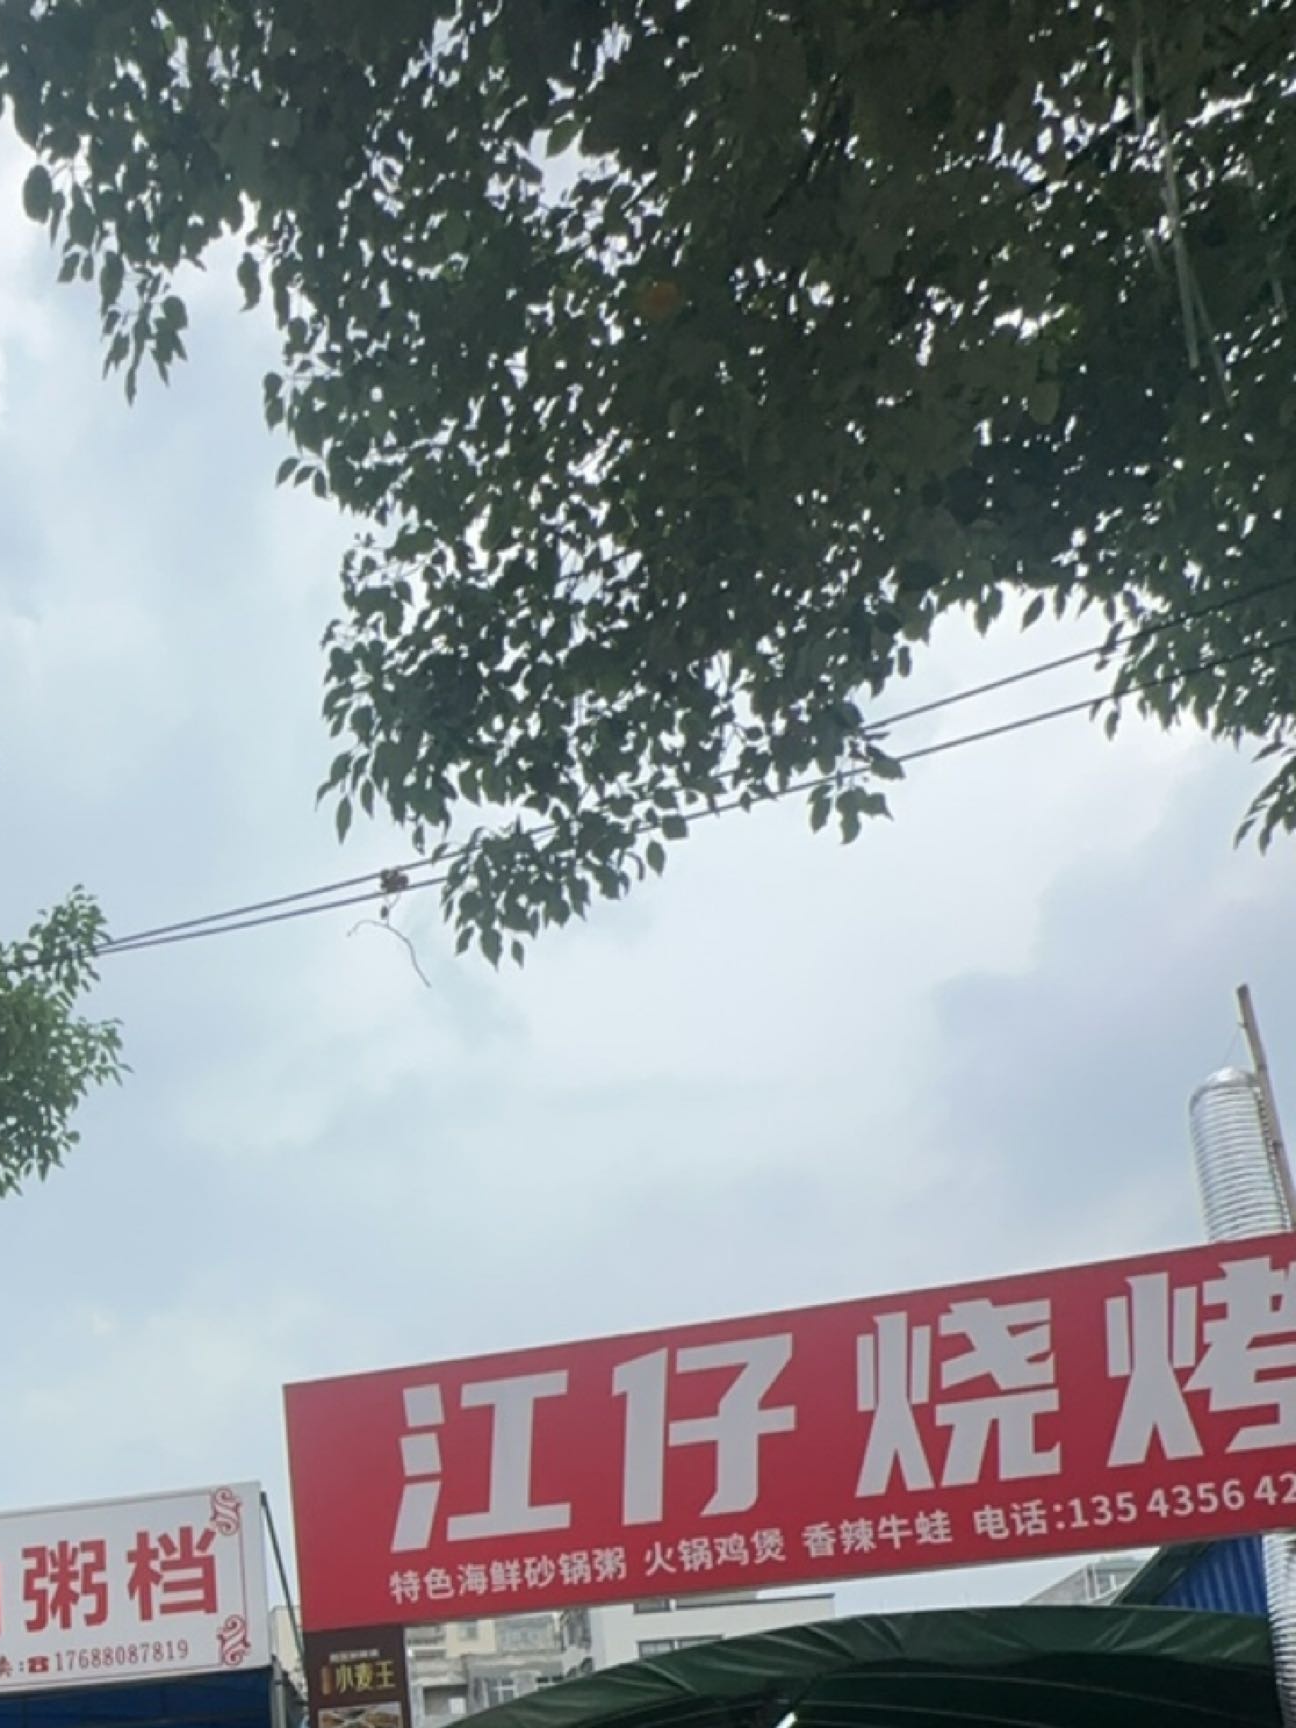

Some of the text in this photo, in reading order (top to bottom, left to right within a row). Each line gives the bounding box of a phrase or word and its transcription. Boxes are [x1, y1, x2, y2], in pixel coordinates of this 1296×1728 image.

[390, 1256, 1296, 1553] 江仔烧烤
[389, 1547, 627, 1605] 特色海鲜砂锅粥
[644, 1526, 787, 1577] 火锅鸡煲
[802, 1508, 952, 1559] 香辣牛蛙
